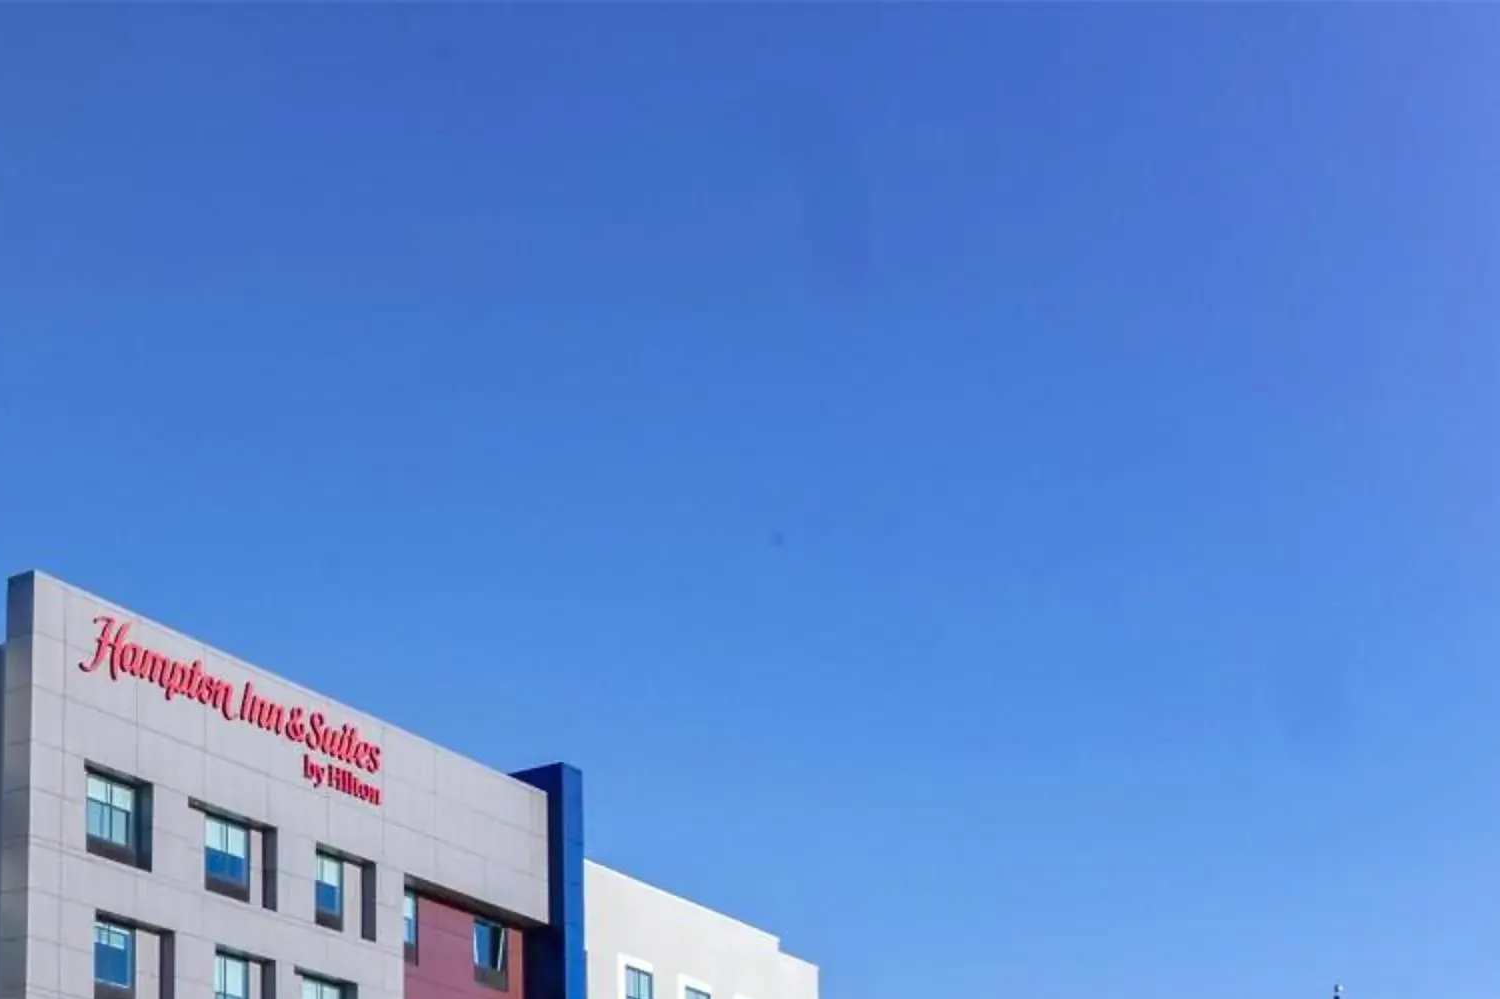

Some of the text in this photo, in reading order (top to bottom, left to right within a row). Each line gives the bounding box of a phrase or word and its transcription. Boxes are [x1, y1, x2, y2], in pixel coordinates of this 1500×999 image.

[78, 615, 237, 721] Hampton
[240, 681, 284, 736] Inn
[305, 712, 381, 774] Suites
[303, 753, 382, 806] by Hilton
